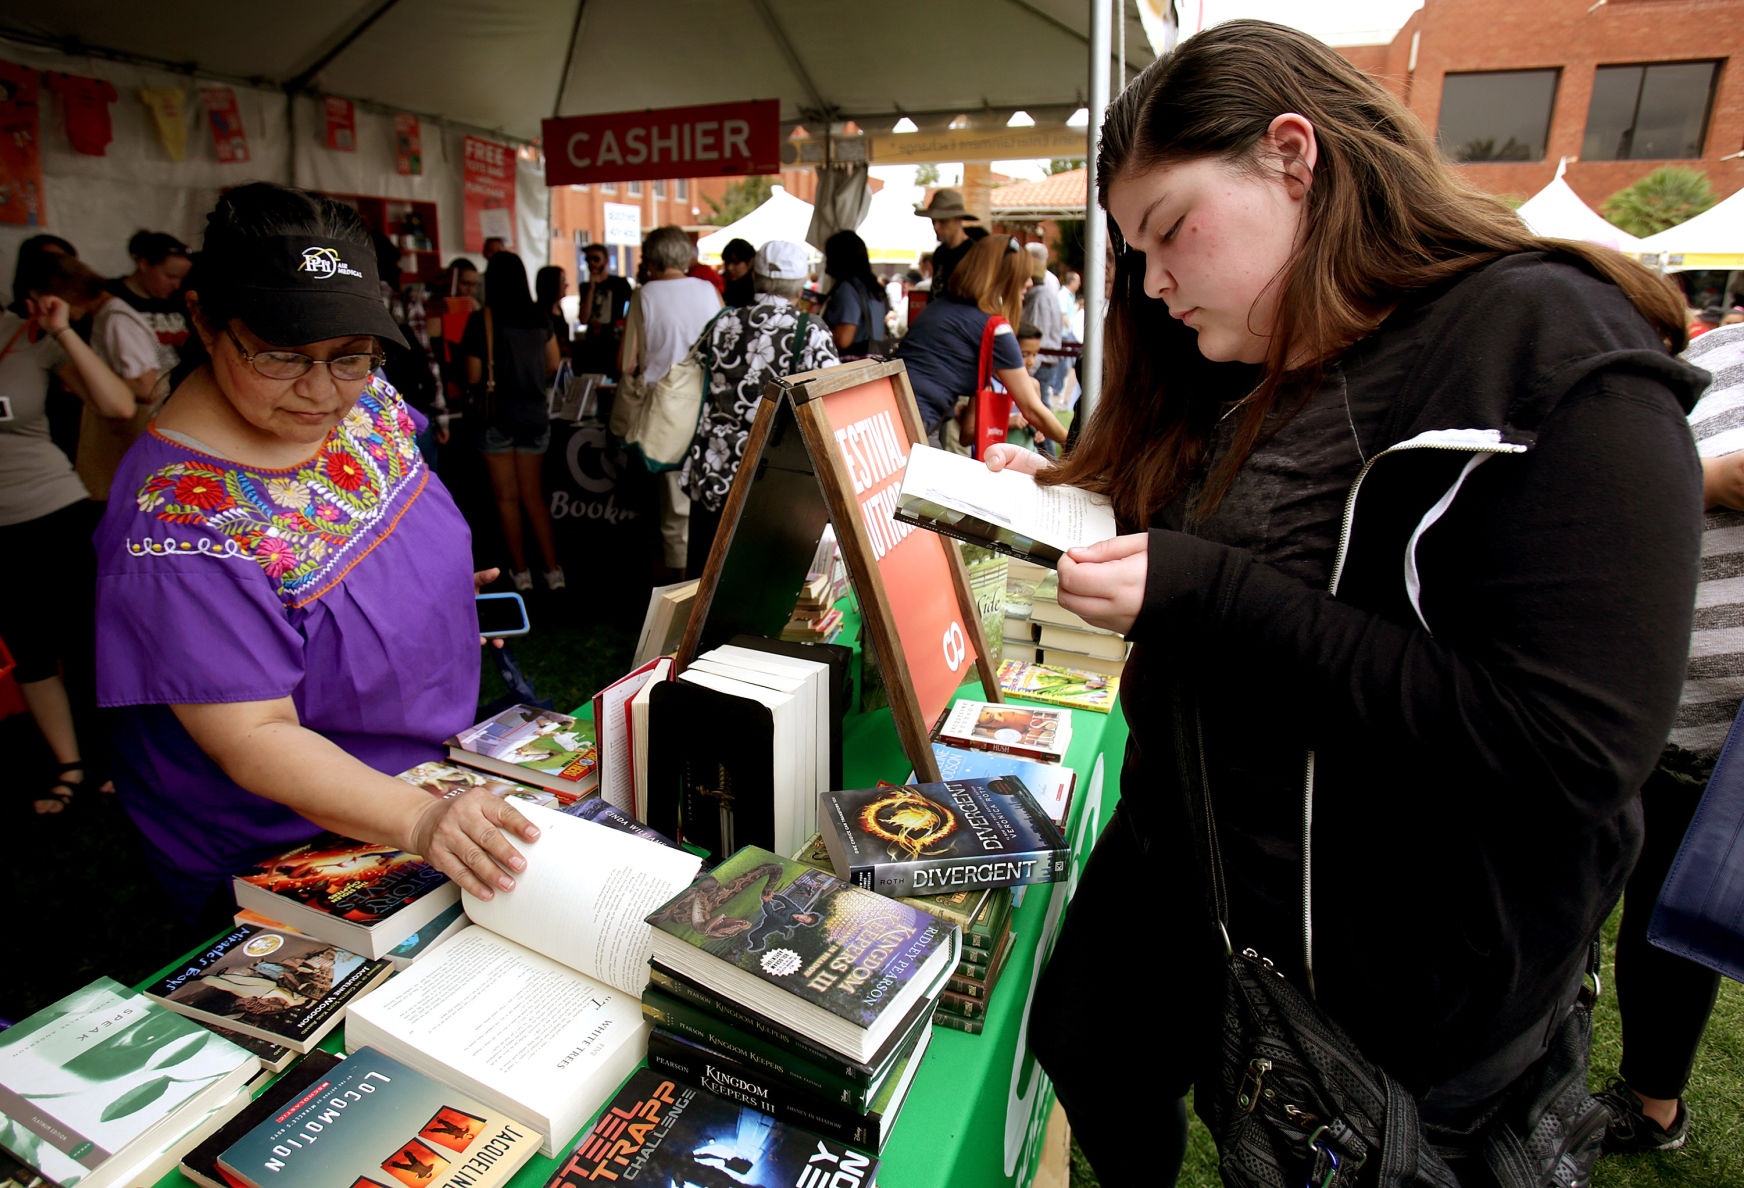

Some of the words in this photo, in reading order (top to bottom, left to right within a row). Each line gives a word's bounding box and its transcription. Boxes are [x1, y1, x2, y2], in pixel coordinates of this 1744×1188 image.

[465, 139, 504, 166] FREE
[567, 119, 751, 168] CASHIER
[337, 268, 363, 278] MEDICAL
[1020, 709, 1060, 749] HUSH
[992, 743, 1010, 752] HUSH
[976, 785, 992, 803] ROTH
[604, 807, 630, 828] CINDA
[944, 782, 1004, 850] DIVERGENT
[990, 804, 1017, 839] VERONICA
[366, 867, 444, 914] STORY
[879, 877, 905, 886] ROTH
[912, 860, 1037, 889] DIVERGENT
[199, 926, 250, 967] Miracle's
[828, 944, 839, 955] IN
[829, 914, 900, 972] KEEPERS
[838, 926, 917, 994] KINGDOM
[908, 925, 939, 962] RIDLEY
[166, 967, 200, 991] Boys
[335, 965, 370, 997] JACQUELINE
[803, 949, 832, 979] SHADOW
[806, 970, 840, 993] III
[864, 959, 910, 1006] PEARSON
[76, 1008, 134, 1042] SPEAK
[297, 995, 337, 1029] WOODSON
[687, 989, 712, 1004] PEARSON
[715, 1001, 755, 1026] KINGDOM
[756, 1021, 790, 1043] KEEPERS
[582, 1018, 613, 1047] WHITE
[679, 1022, 704, 1038] PEARSON
[708, 1033, 748, 1057] KINGDOM
[749, 1051, 784, 1073] KEEPERS
[556, 1044, 586, 1070] TREES
[655, 1055, 690, 1074] PEARSON
[704, 1064, 769, 1099] KINGDOM
[278, 1088, 322, 1122] SCHOLASTIC
[700, 1076, 758, 1110] KEEPERS
[760, 1100, 776, 1114] III
[264, 1071, 392, 1173] LOCOMOTION
[285, 1103, 318, 1129] MIRACLE'S
[589, 1080, 676, 1182] TRAPP
[268, 1127, 287, 1142] BOYS
[622, 1088, 698, 1182] CHALLENGE
